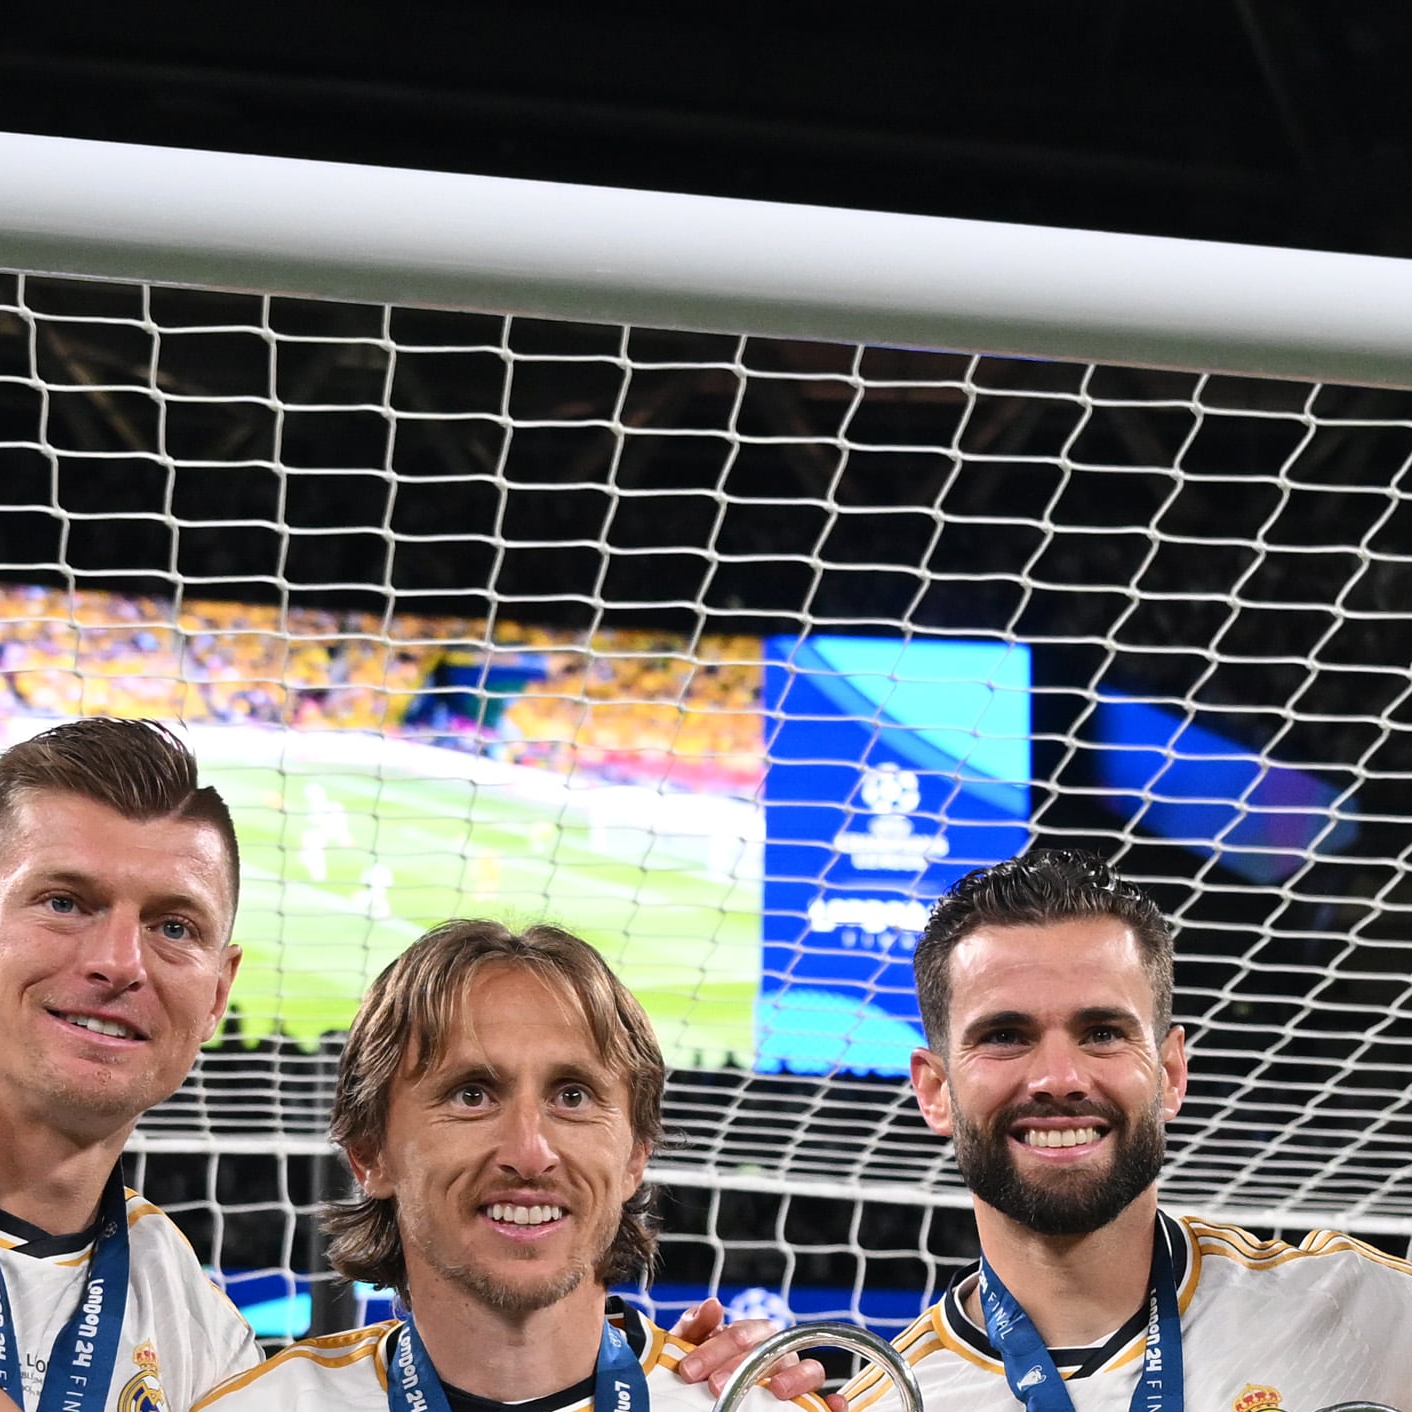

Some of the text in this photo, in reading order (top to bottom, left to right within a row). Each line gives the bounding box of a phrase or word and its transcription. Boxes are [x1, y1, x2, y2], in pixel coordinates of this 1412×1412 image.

[988, 1291, 1014, 1340] FINAL
[72, 1339, 94, 1368] 24
[1145, 1347, 1163, 1372] 24
